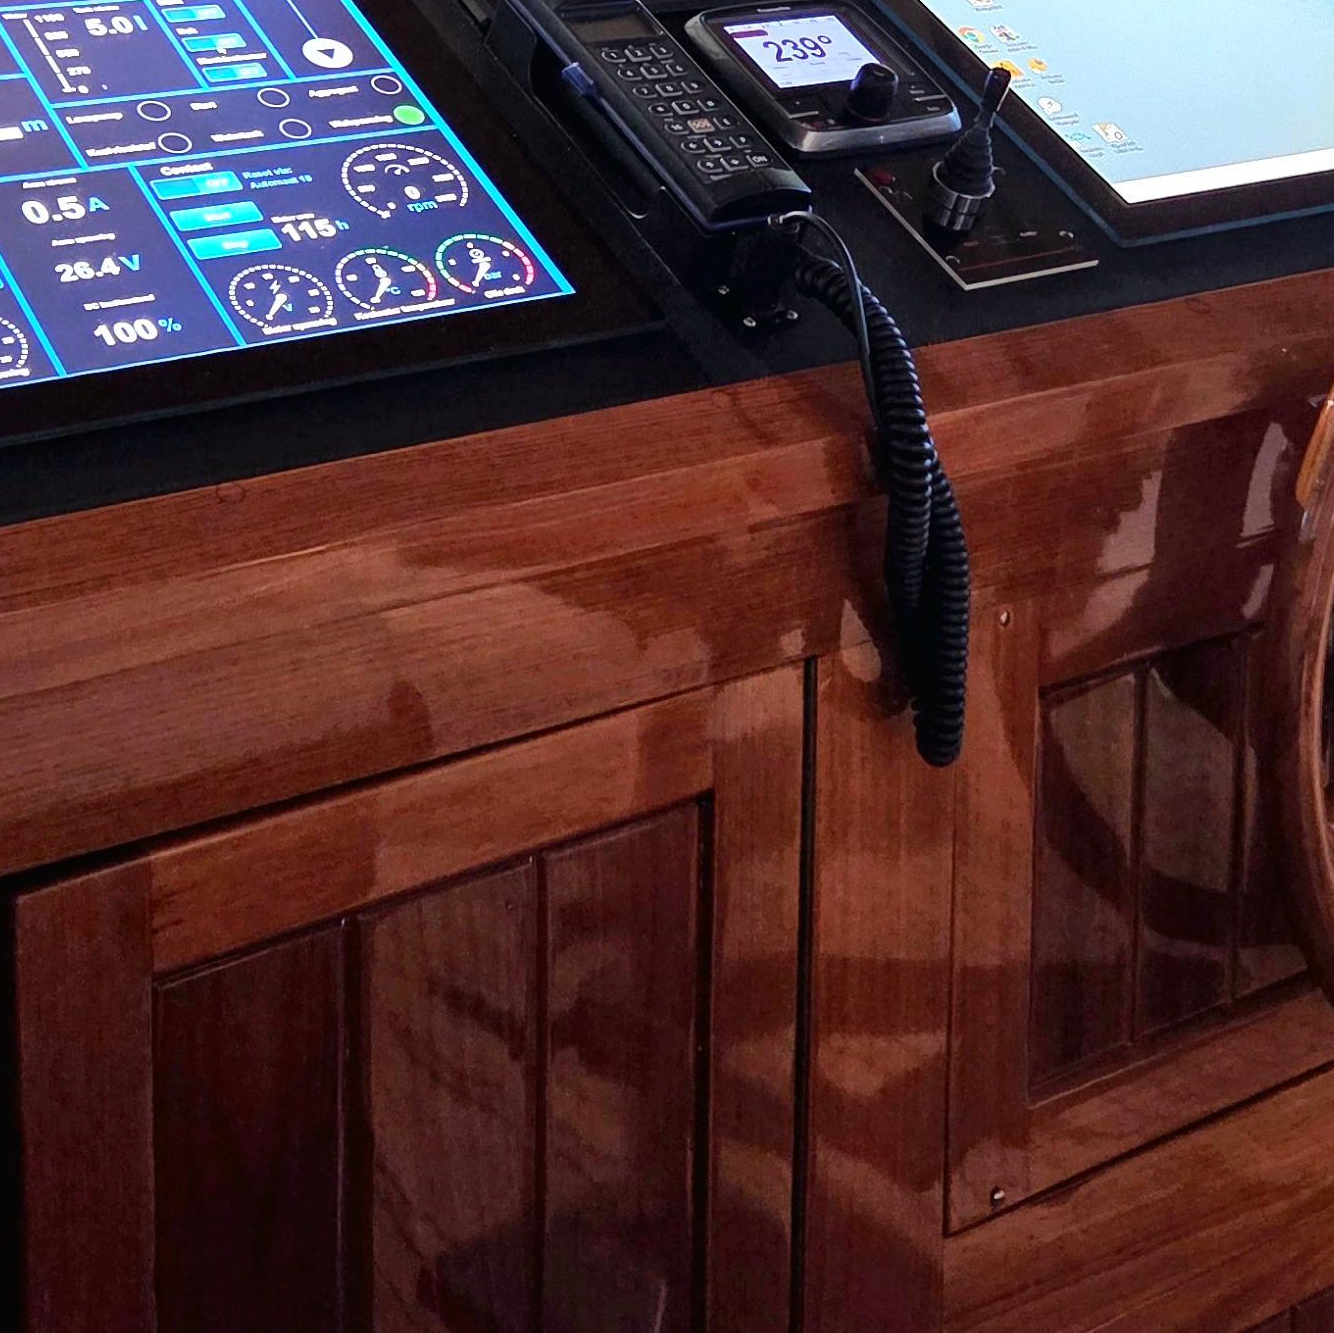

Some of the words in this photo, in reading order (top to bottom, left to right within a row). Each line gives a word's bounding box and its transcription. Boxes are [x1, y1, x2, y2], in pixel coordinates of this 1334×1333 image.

[85, 17, 133, 36] 5.0
[763, 35, 832, 62] 239°
[22, 120, 47, 131] m
[160, 162, 213, 176] Contact
[404, 186, 420, 199] 0
[22, 196, 85, 224] 0.5
[89, 198, 106, 211] A
[410, 201, 435, 212] rpm
[282, 218, 336, 241] 115
[336, 220, 348, 230] h
[55, 257, 120, 282] 26.4
[123, 256, 139, 270] V
[94, 319, 157, 345] 100
[159, 319, 181, 331] %
